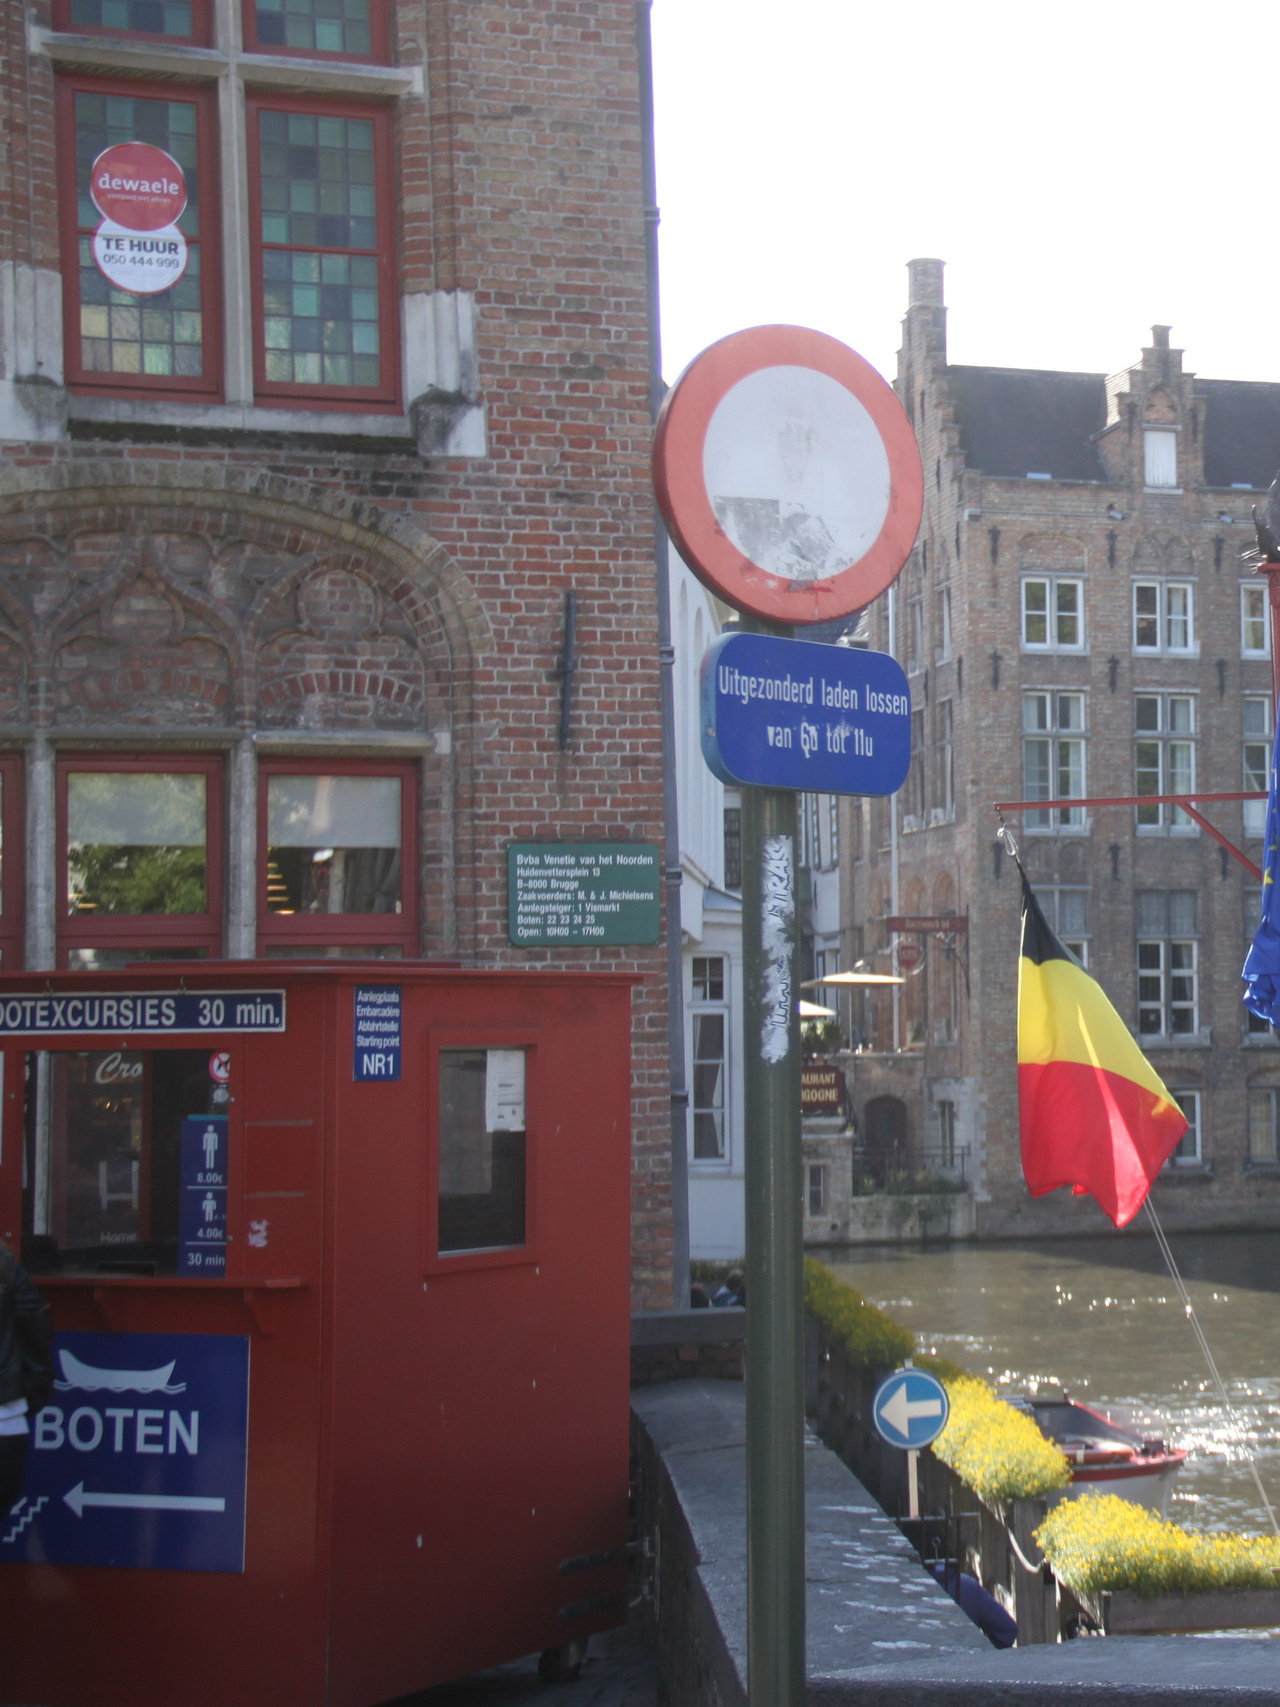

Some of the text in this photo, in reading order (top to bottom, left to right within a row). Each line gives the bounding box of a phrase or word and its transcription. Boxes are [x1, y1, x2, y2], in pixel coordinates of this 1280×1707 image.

[98, 173, 179, 195] dewaele
[103, 238, 179, 255] TE HUUR
[103, 254, 180, 269] 050 444 999
[719, 665, 908, 716] Uitgezonderd laden lossen
[767, 726, 792, 748] van
[827, 724, 846, 753] tot
[854, 728, 873, 757] 11u
[517, 854, 653, 865] Bvba Venetie van het Noorden
[517, 867, 600, 878] Huidenvettersplein 13
[517, 879, 579, 891] B-8000 Brugge
[517, 890, 654, 900] Zaakvoerders: M. & J. Michielsens
[518, 903, 575, 915] Aanlegsteiger:
[585, 903, 620, 912] Vismarkt
[517, 915, 595, 924] Boten: 22 23 24 25
[517, 927, 542, 939] Open:
[546, 926, 569, 936] 10H00
[582, 926, 605, 936] 17H00
[357, 990, 400, 1005] Aanlegplaats
[0, 997, 280, 1028] OTEXCURSIES 30 min.
[356, 1005, 400, 1017] Embarcadère
[357, 1020, 399, 1032] Abfahrtstelle
[356, 1035, 400, 1049] Starting point
[363, 1053, 394, 1075] NR1
[187, 1252, 226, 1267] 30 min
[34, 1406, 199, 1456] BOTEN
